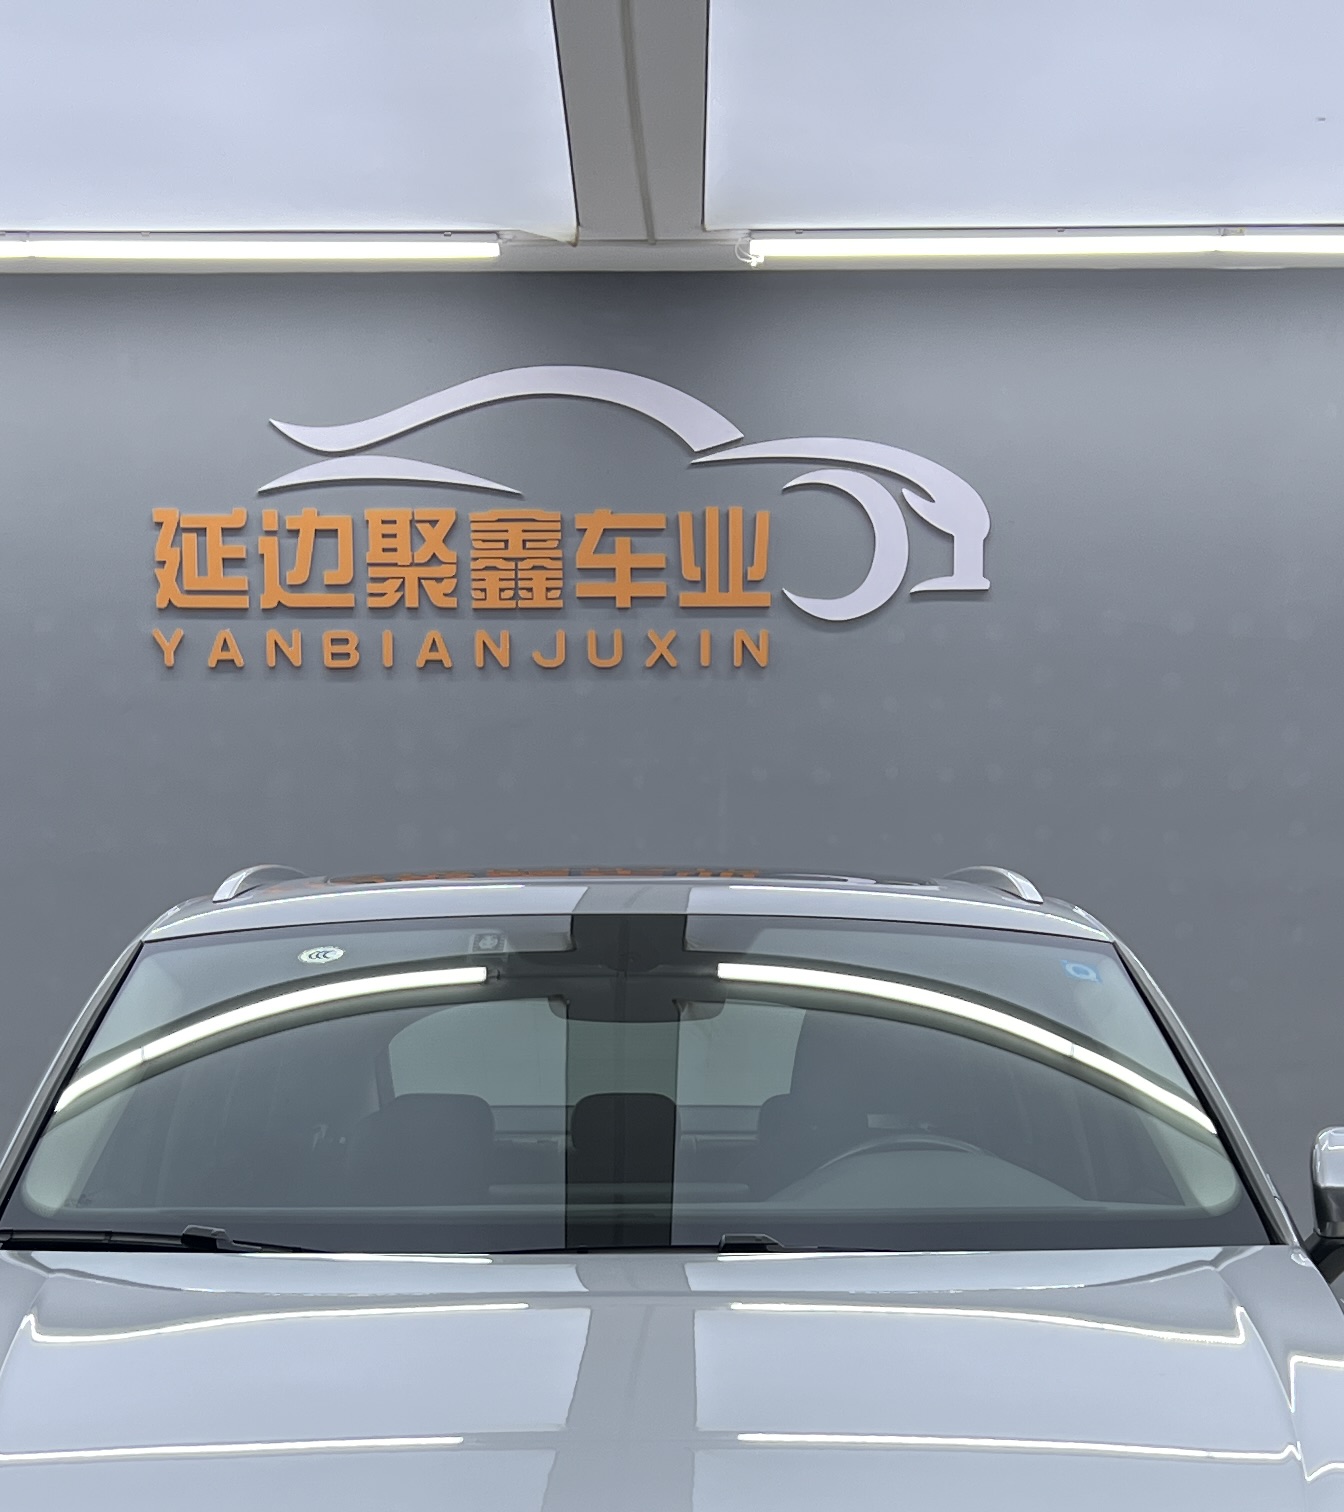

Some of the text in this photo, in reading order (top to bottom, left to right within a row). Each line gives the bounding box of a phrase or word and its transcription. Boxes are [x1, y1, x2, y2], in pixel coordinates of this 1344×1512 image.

[152, 506, 771, 609] 延边聚鑫车业
[152, 628, 770, 668] YANBIANJUXIN
